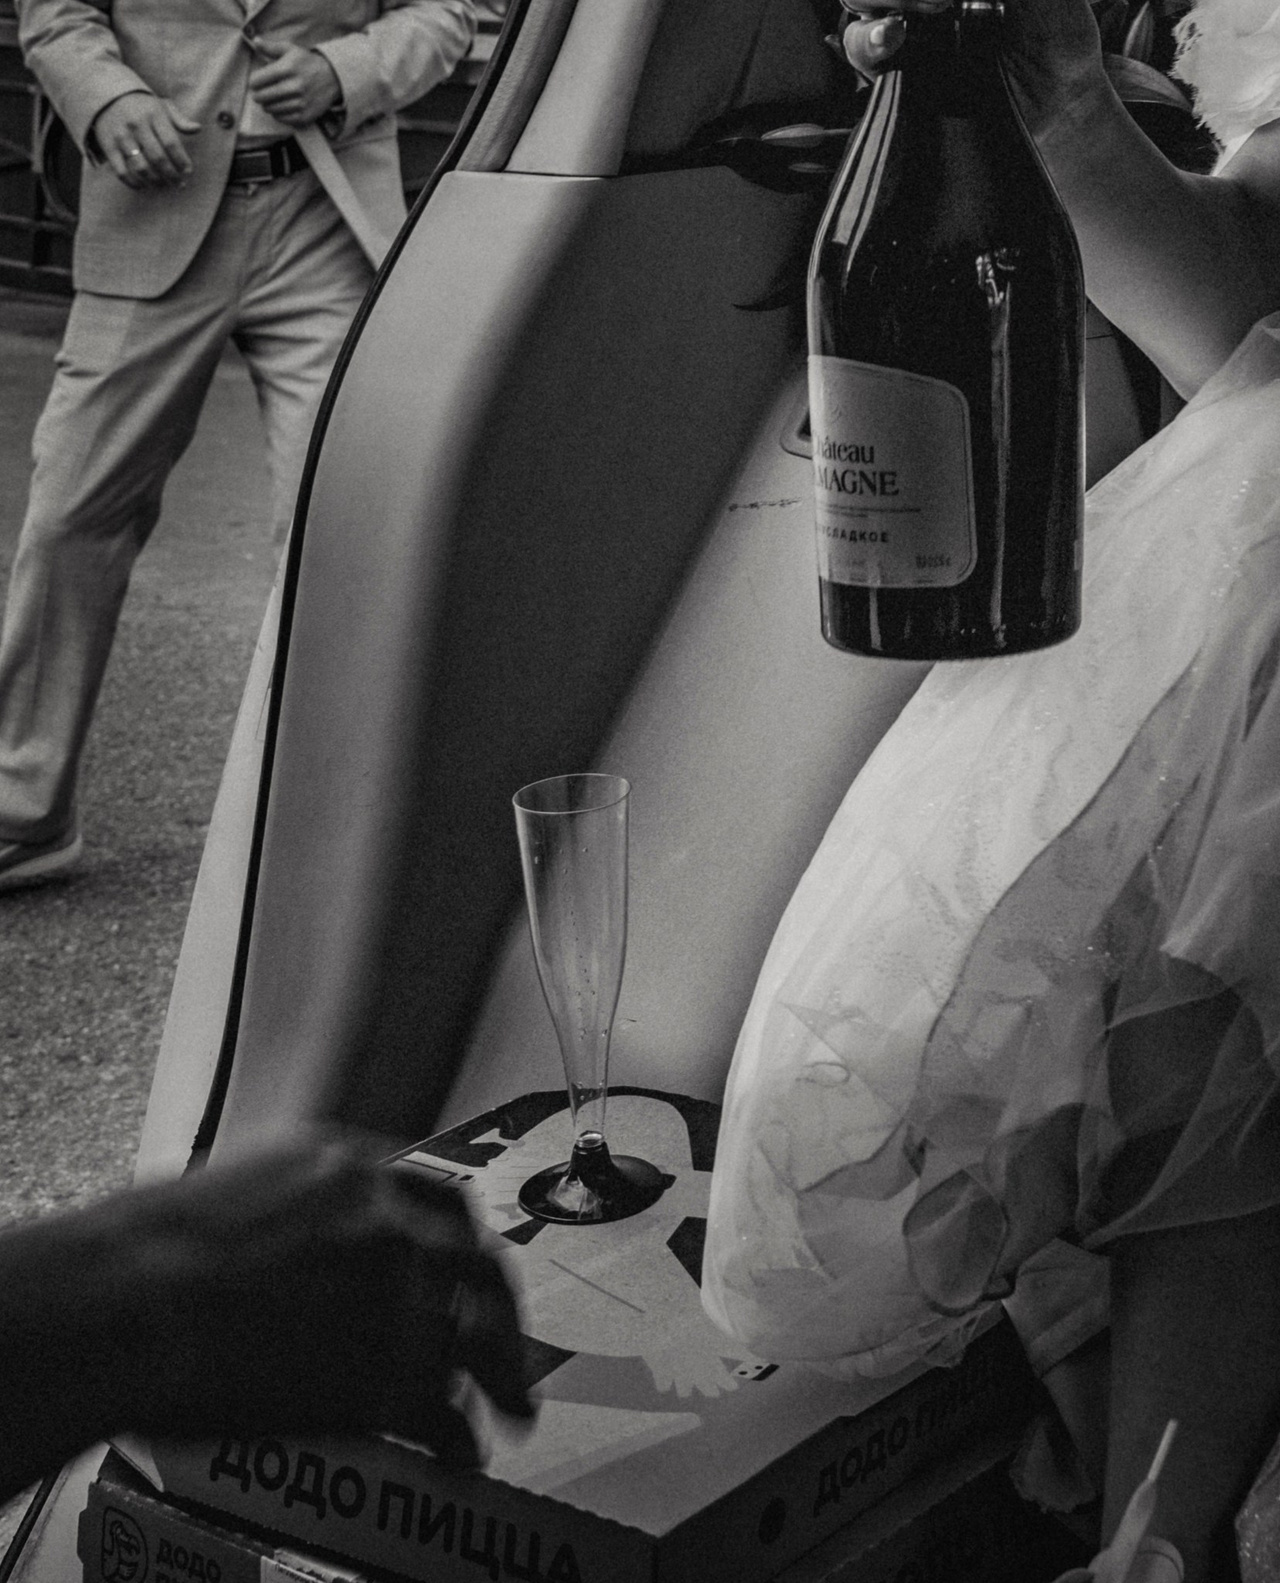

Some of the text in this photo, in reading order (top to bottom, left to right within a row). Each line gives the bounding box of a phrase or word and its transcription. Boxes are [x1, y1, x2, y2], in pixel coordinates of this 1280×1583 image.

[209, 1437, 583, 1583] ДОДО ПИЦЦА
[156, 1537, 221, 1583] ДОДО
